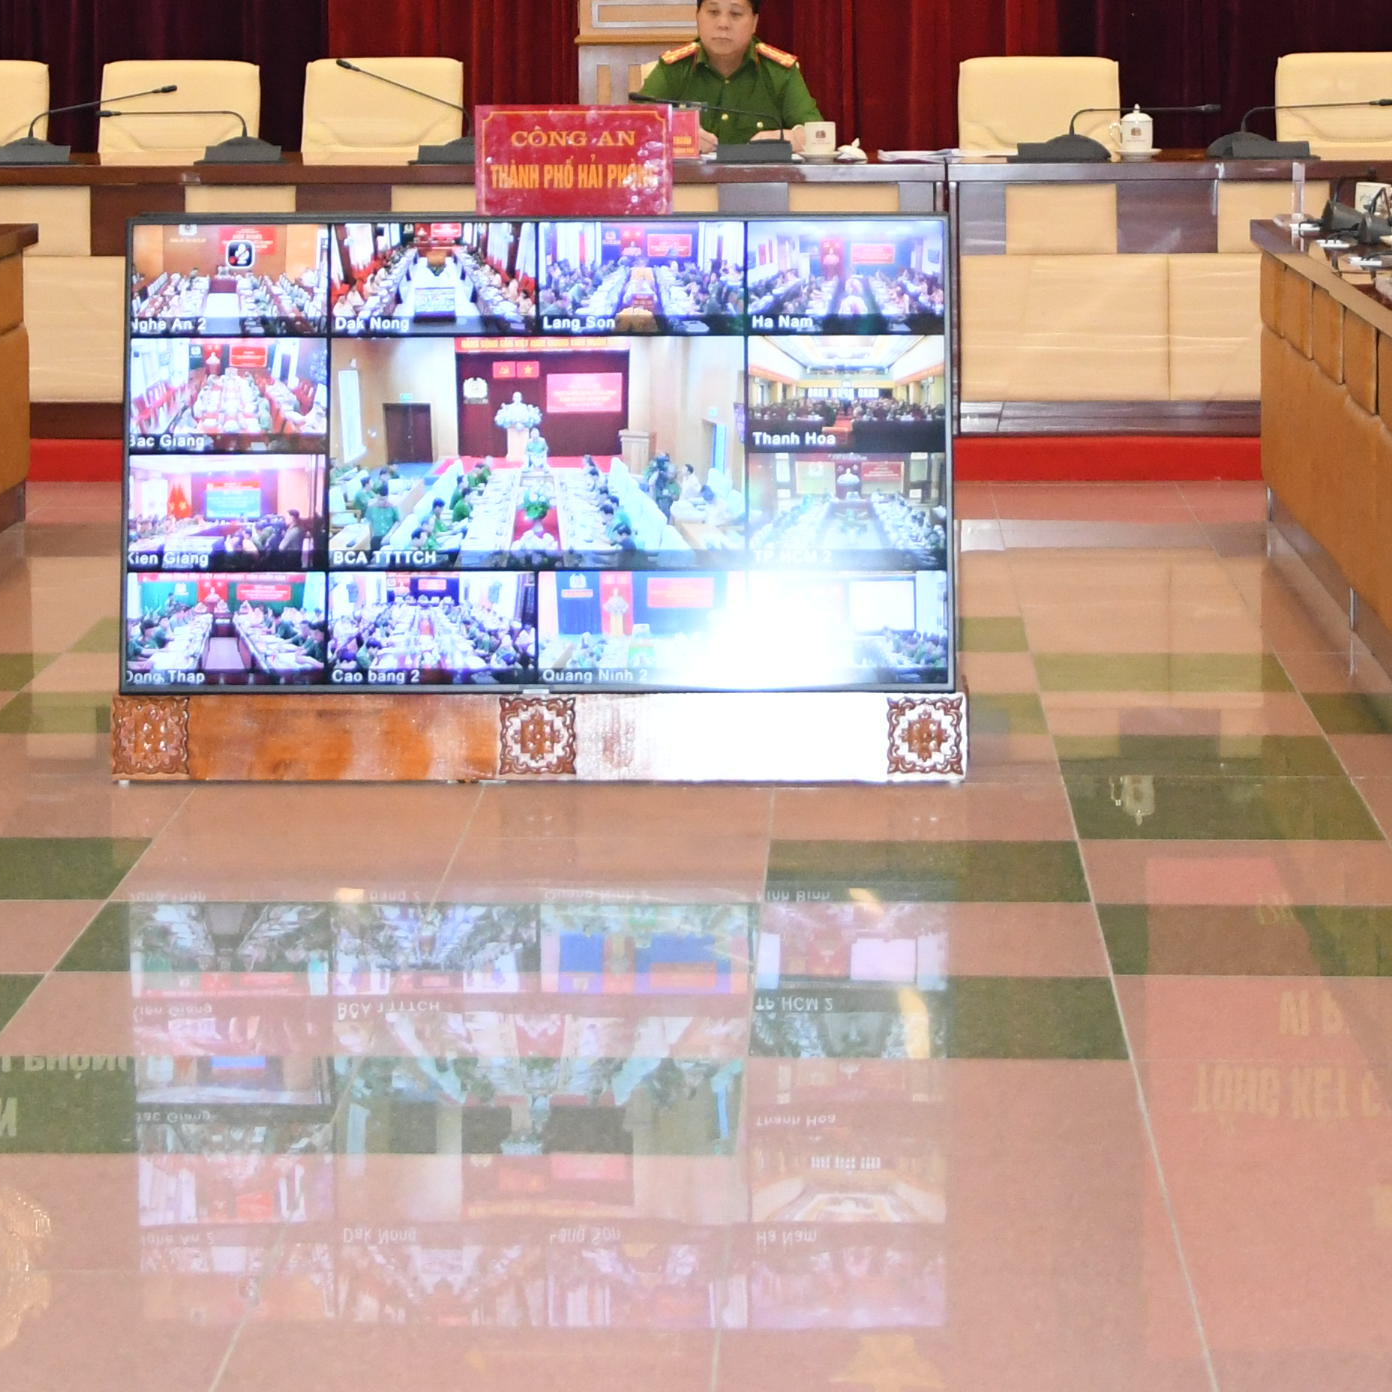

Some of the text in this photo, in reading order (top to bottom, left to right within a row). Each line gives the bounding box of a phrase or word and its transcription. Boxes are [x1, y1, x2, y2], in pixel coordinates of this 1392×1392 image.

[510, 125, 636, 147] CÔNG AN
[490, 159, 539, 189] THÀNH
[544, 156, 574, 189] PHỐ
[578, 154, 602, 188] HẢI
[171, 319, 192, 330] An
[198, 318, 207, 330] 2
[335, 316, 409, 333] Dak Nong
[543, 316, 616, 333] Lang Son
[752, 315, 814, 329] Ha Nam
[160, 436, 204, 450] Giang
[752, 432, 836, 445] Thanh Hoa
[163, 552, 209, 567] Giang
[333, 550, 437, 565] BCA TTTTCH
[169, 671, 206, 686] Thap
[332, 669, 420, 686] Cao bang 2
[542, 670, 648, 685] Quang Ninh 2
